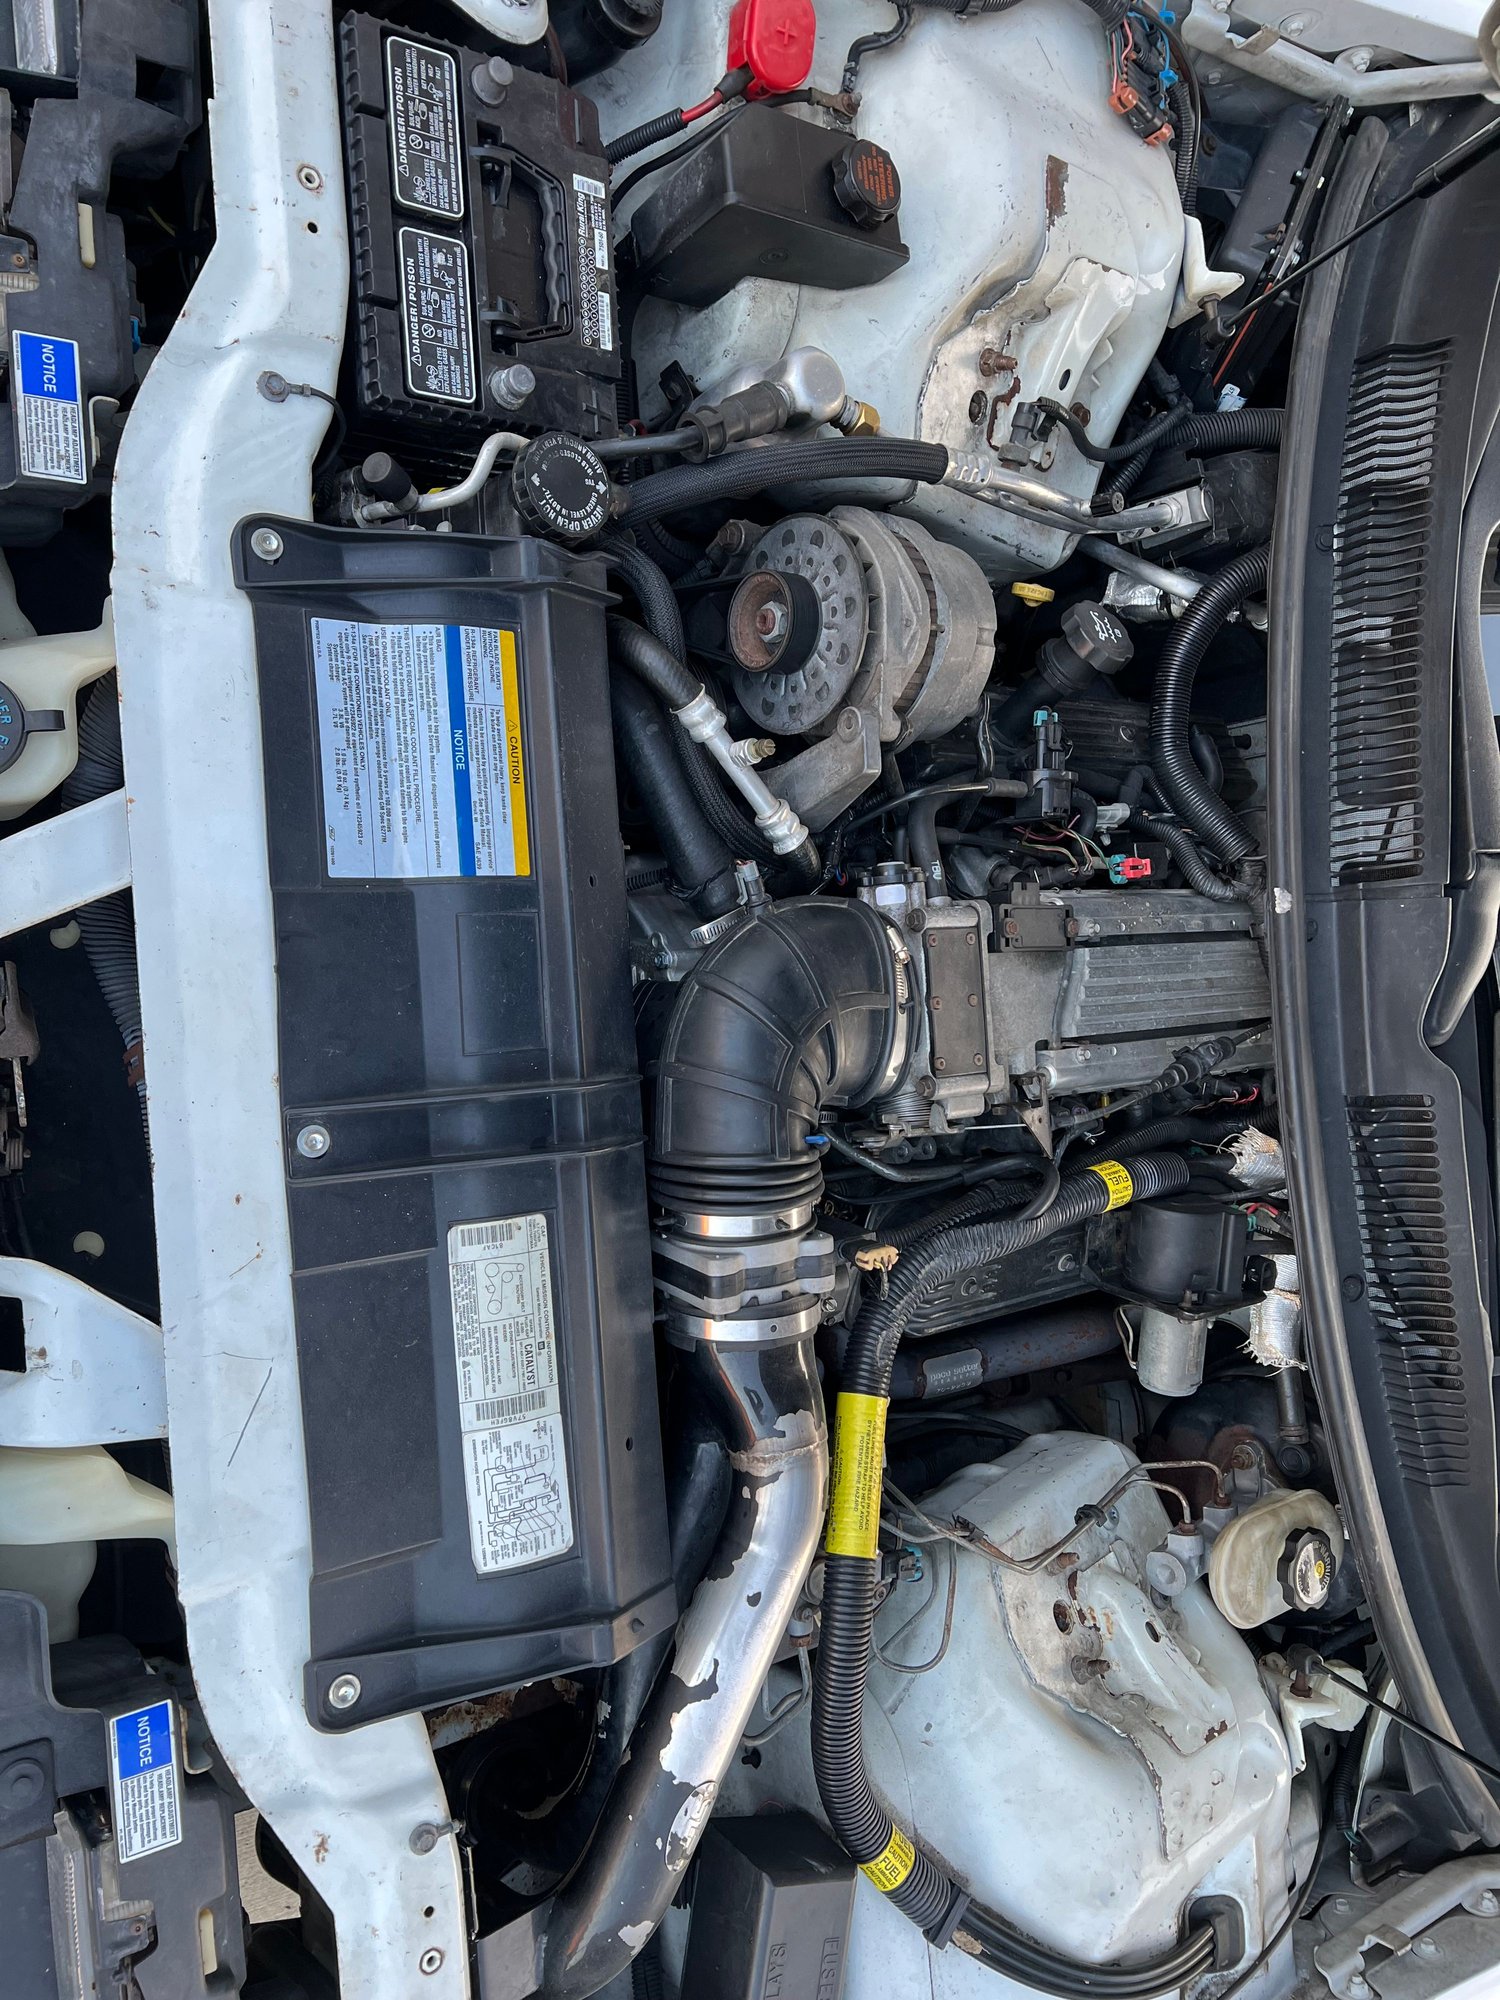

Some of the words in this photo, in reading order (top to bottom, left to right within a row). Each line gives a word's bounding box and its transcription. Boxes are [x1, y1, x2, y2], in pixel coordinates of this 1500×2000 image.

[394, 66, 406, 163] DANGER/POISON
[877, 156, 886, 200] STEERING
[885, 164, 894, 197] POWER
[576, 192, 585, 212] King
[577, 212, 585, 236] Rural
[406, 257, 420, 353] DANGER/POISON
[41, 343, 56, 392] NOTICE
[69, 406, 77, 437] HEADLAMP
[63, 436, 71, 473] REPLACEMENT
[71, 438, 80, 476] ADJUSTMENT
[542, 487, 559, 511] BOTTL
[569, 509, 587, 518] LEVEL
[585, 492, 597, 512] CHECK
[556, 515, 580, 530] OPEN
[581, 505, 604, 530] NEVER
[471, 649, 479, 694] REFRIGERANT
[454, 729, 464, 770] NOTICE
[509, 736, 520, 784] CAUTION
[1107, 1174, 1128, 1186] FUEL
[524, 1343, 535, 1384] CATALYST
[865, 1419, 871, 1427] BY
[861, 1483, 866, 1491] TO
[868, 1474, 872, 1482] BE
[1320, 1543, 1330, 1588] WARNING
[136, 1715, 152, 1767] NOTICE
[164, 1769, 172, 1799] HEADLAMP
[166, 1801, 174, 1837] ADJUSTMENT
[880, 1856, 902, 1882] FUEL
[888, 1846, 910, 1871] CAUTION
[866, 1866, 888, 1890] CAUTION
[818, 1940, 839, 2000] FUSE
